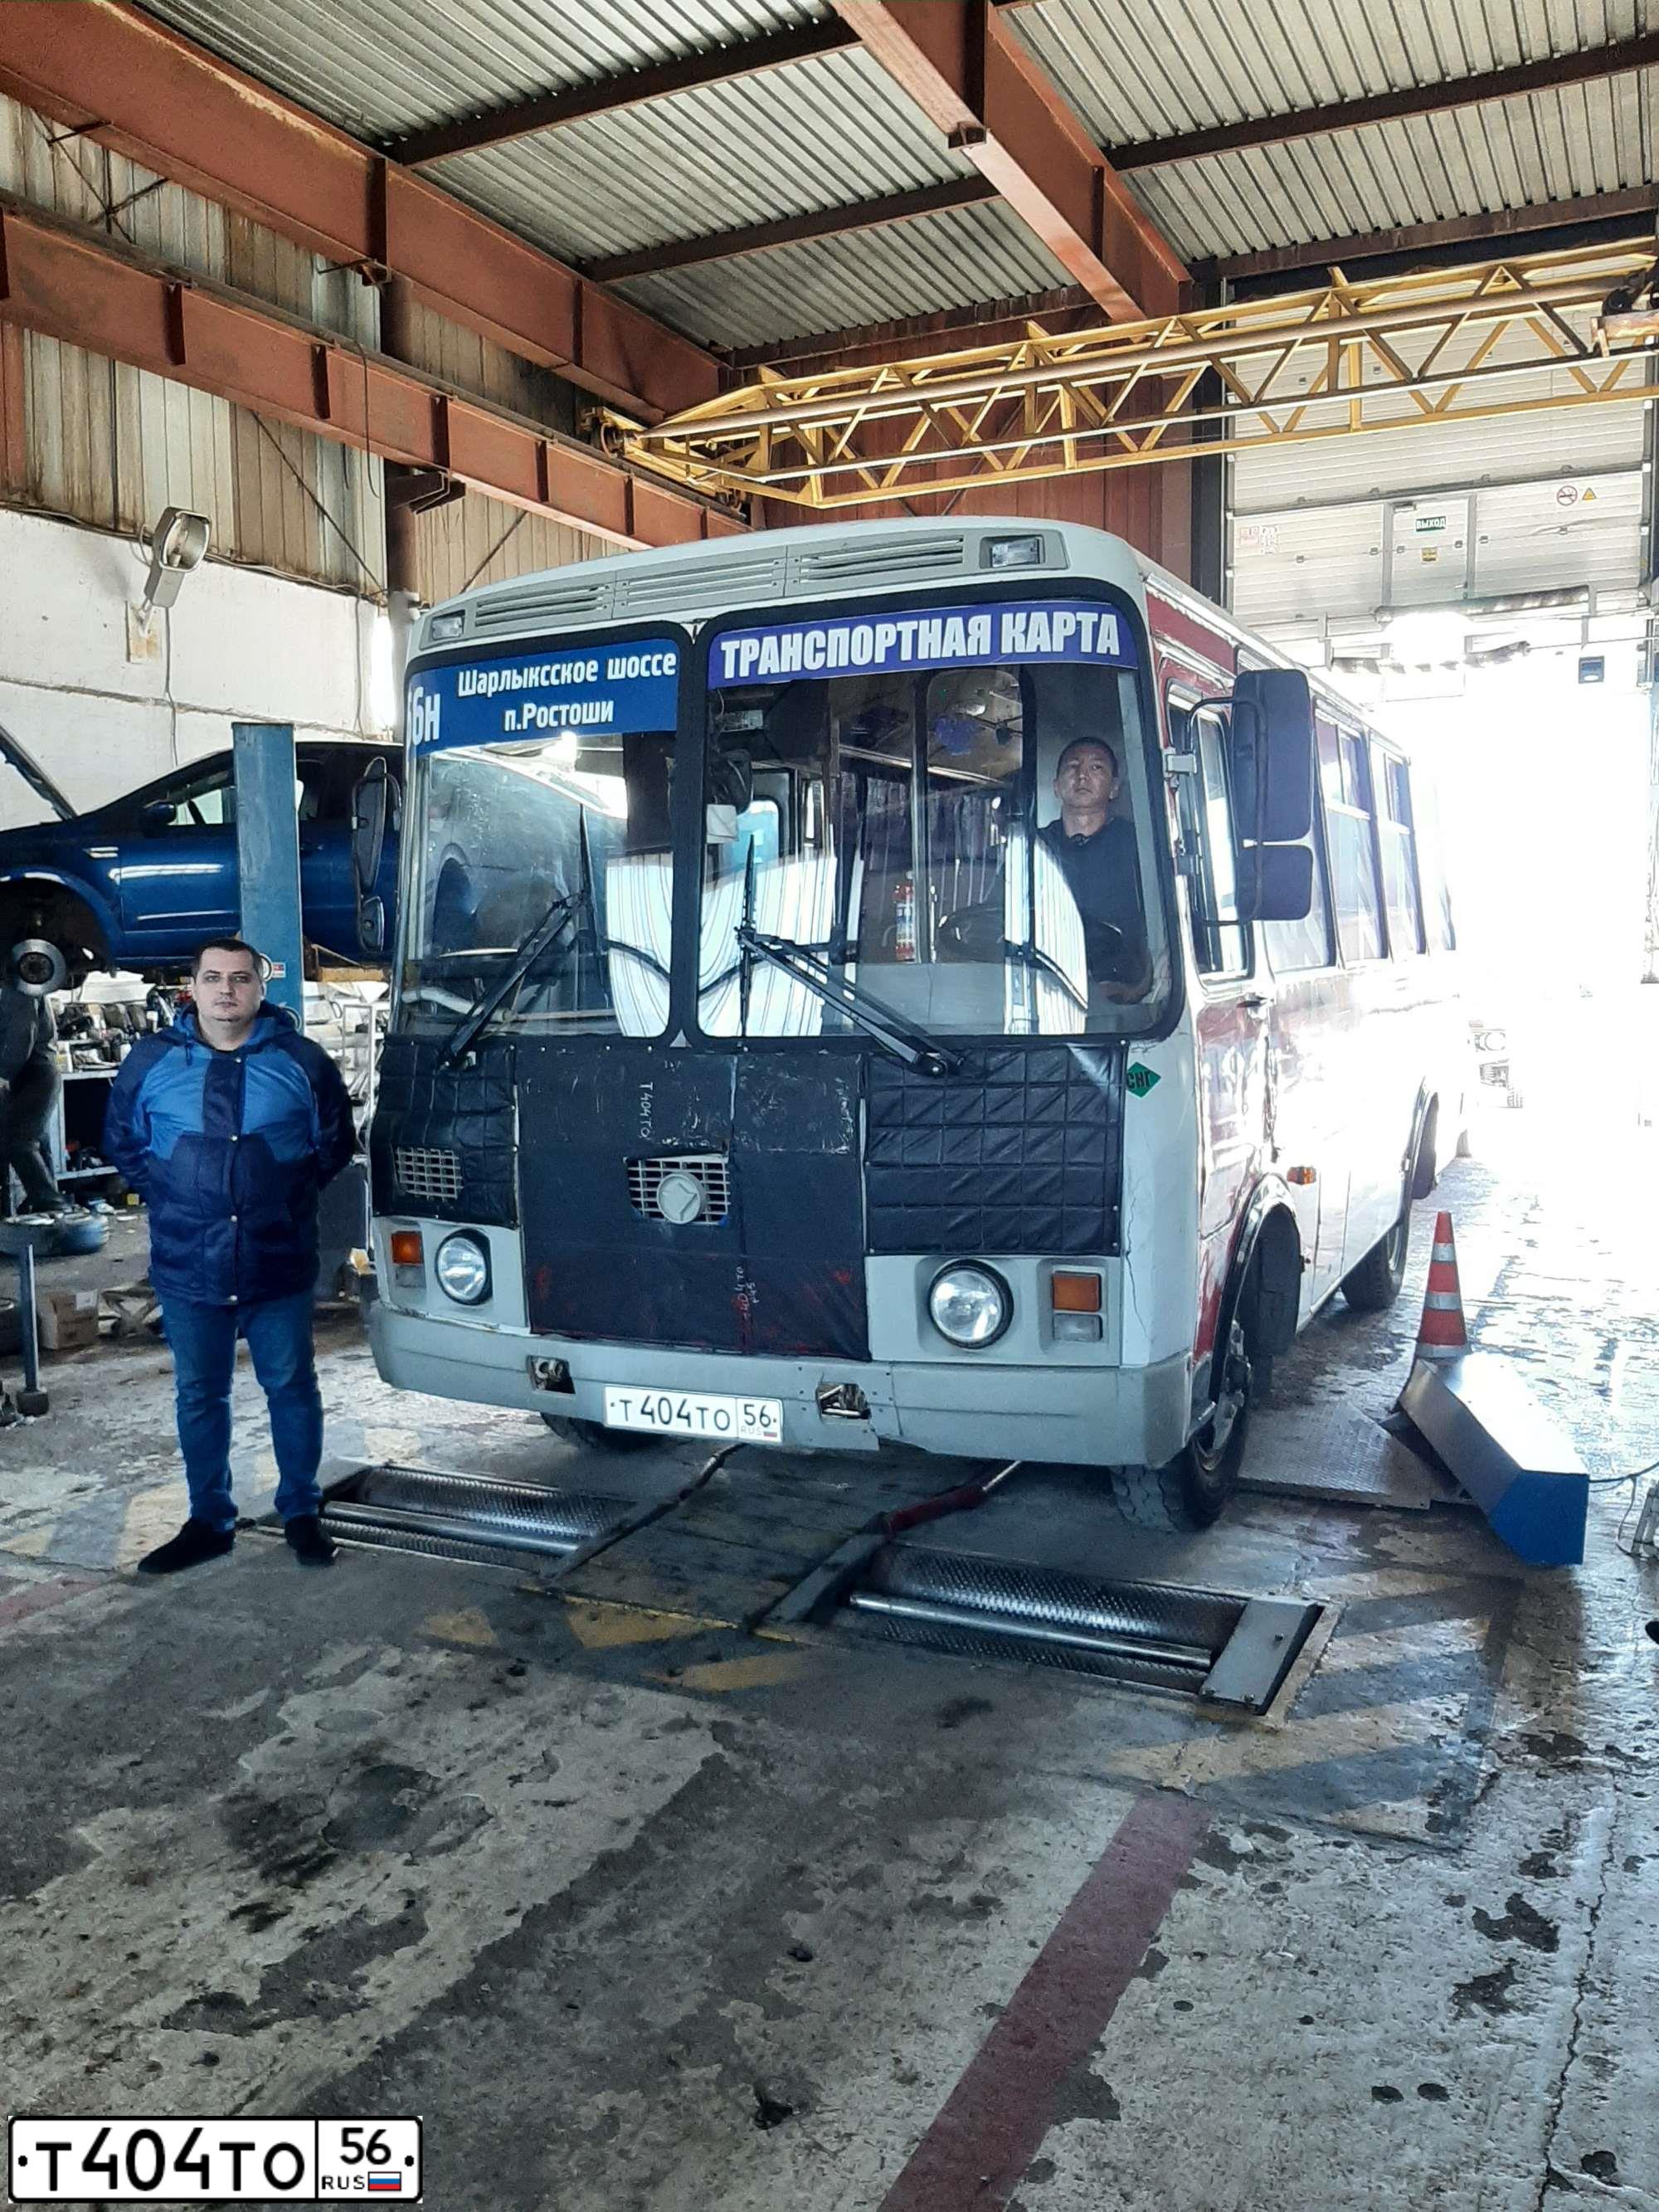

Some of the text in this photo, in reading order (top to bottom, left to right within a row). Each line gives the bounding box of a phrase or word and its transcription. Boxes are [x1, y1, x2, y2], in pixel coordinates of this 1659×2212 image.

[1416, 517, 1446, 529] ВЫХОД
[720, 611, 1121, 679] ТРАНСПОРТНАЯ КАРТА
[458, 652, 677, 698] Шарлыксское шоссе
[504, 700, 615, 731] п.Ростоши
[619, 1395, 731, 1431] Т404ТО
[743, 1404, 771, 1427] 56
[741, 1425, 762, 1435] RUS
